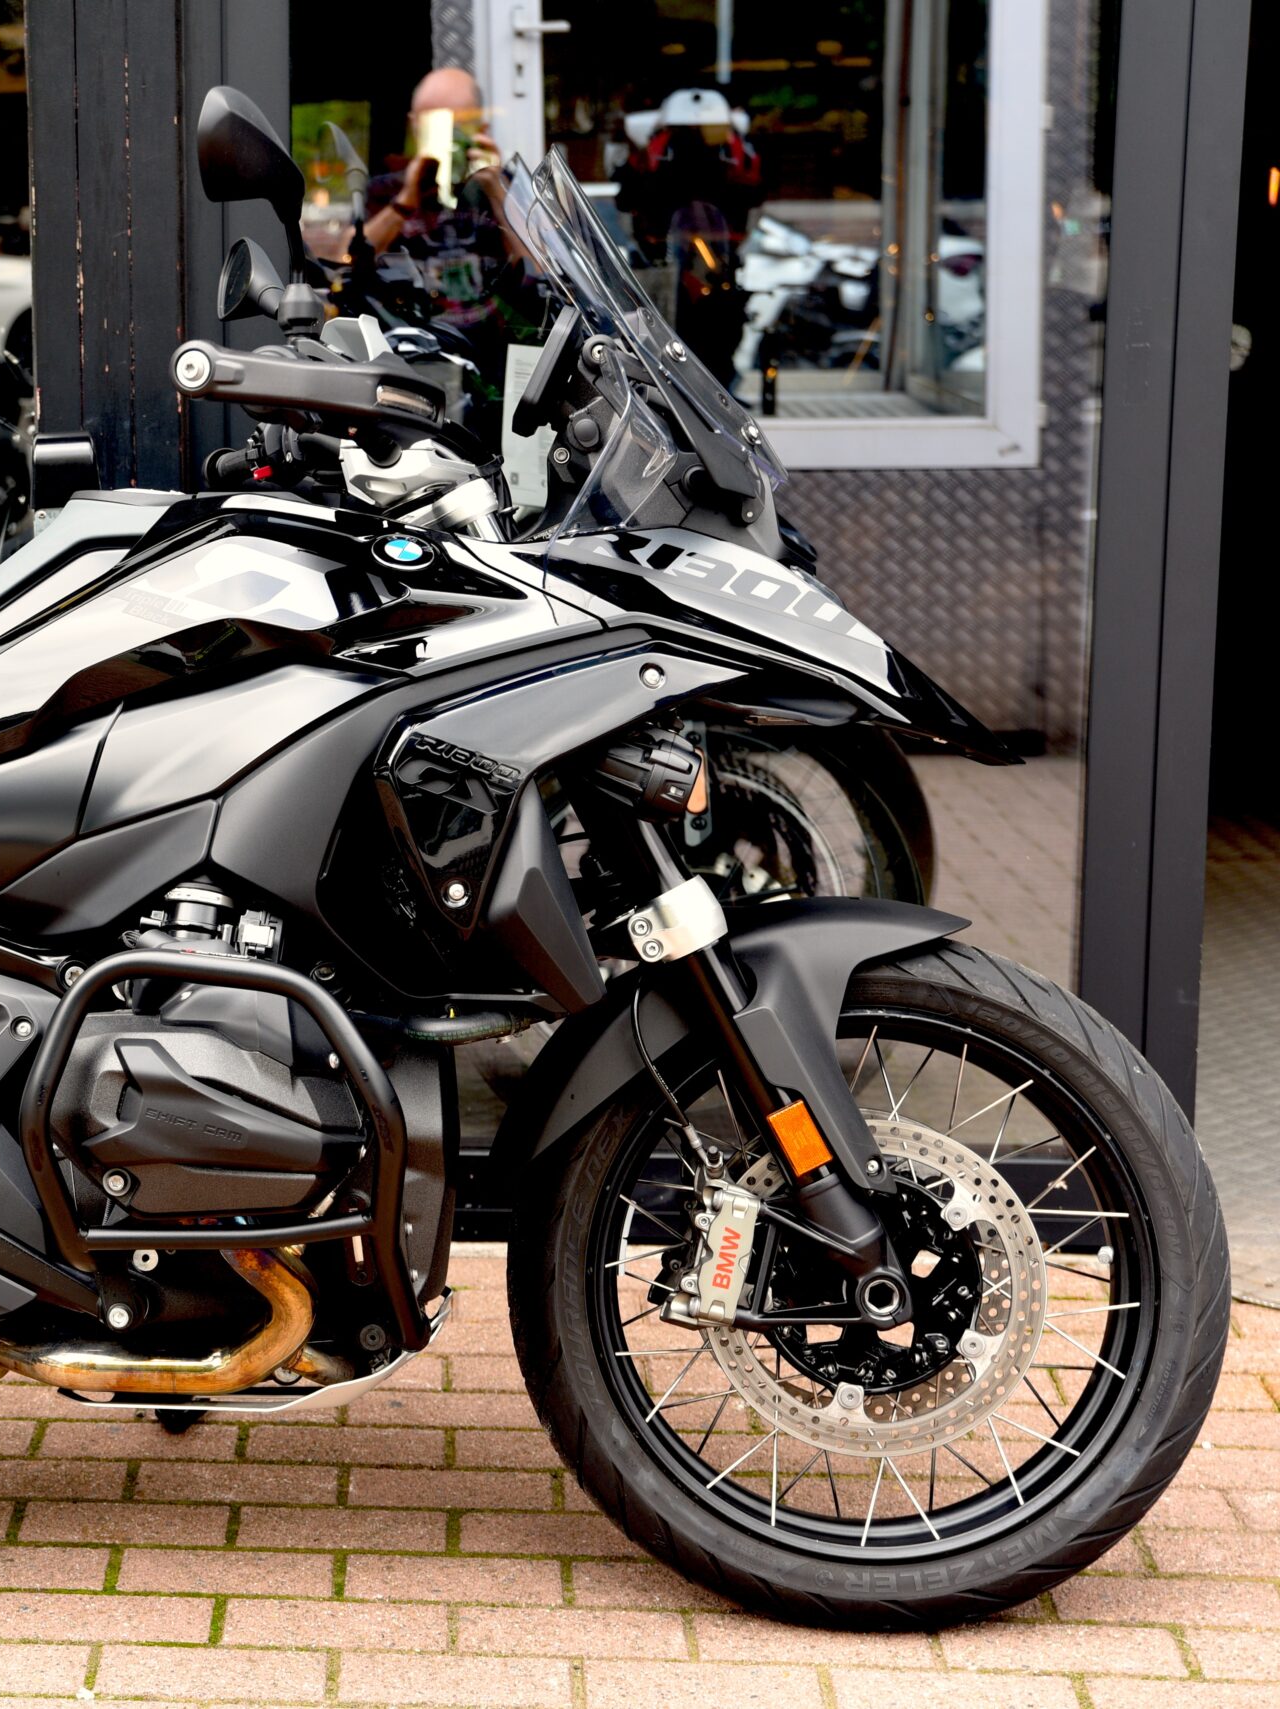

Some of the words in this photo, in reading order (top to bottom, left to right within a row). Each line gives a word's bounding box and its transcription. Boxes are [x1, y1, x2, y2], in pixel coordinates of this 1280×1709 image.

[128, 603, 170, 625] Black
[145, 1107, 198, 1130] SHIFT
[203, 1123, 242, 1143] CAM
[583, 1098, 629, 1186] NEX
[711, 1226, 742, 1290] BMW
[844, 1517, 1062, 1595] METZELER
